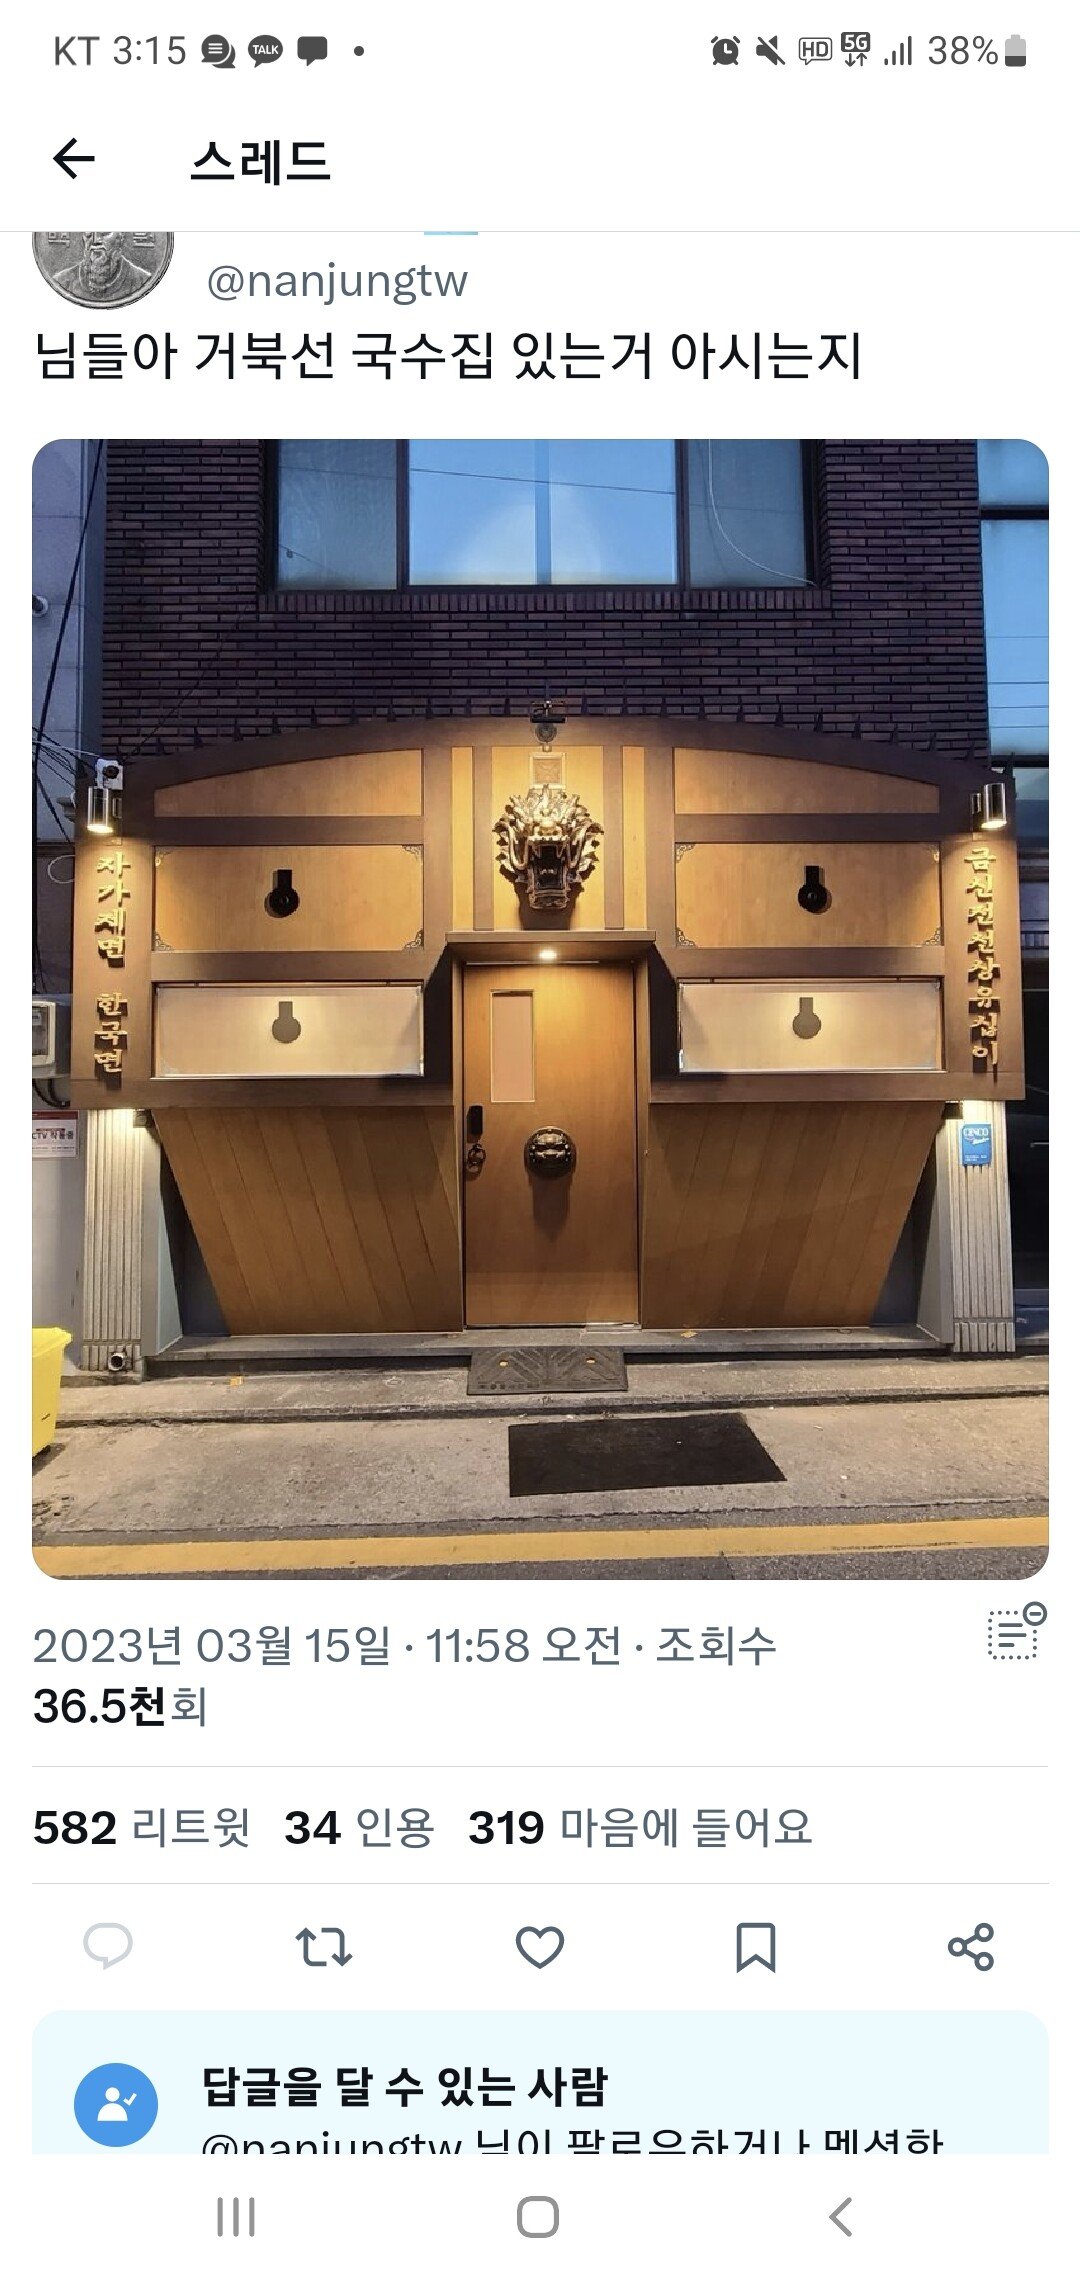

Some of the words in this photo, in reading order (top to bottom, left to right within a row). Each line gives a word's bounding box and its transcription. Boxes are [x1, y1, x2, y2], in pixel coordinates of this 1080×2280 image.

[55, 36, 100, 66] KT
[114, 36, 186, 66] 3:15
[253, 45, 279, 55] TALK
[802, 41, 829, 57] HD
[844, 34, 867, 50] 5G
[928, 35, 998, 65] 38%
[190, 140, 331, 186] 스레드
[207, 262, 469, 305] @nanjungtw
[36, 332, 178, 380] 님들아
[196, 332, 334, 380] 거북선
[352, 332, 492, 380] 국수집
[513, 332, 651, 380] 있는거
[672, 332, 860, 380] 아시는지
[95, 851, 131, 958] 자가제면
[94, 992, 128, 1073] 한국면
[34, 1626, 181, 1666] 2023년
[197, 1626, 291, 1666] 03월
[305, 1626, 390, 1666] 15일
[426, 1629, 530, 1663] 11:58
[543, 1626, 620, 1666] 오전
[657, 1626, 777, 1667] 조회수
[34, 1686, 206, 1728] 36.5천회
[34, 1810, 117, 1845] 582
[134, 1808, 249, 1849] 리트윗
[285, 1810, 342, 1845] 34
[357, 1808, 435, 1849] 인용
[469, 1810, 545, 1845] 319
[562, 1808, 678, 1849] 마음에
[693, 1808, 813, 1849] 들어요
[203, 2067, 322, 2108] 답글을
[337, 2067, 374, 2108] 달
[386, 2067, 424, 2108] 수
[438, 2067, 516, 2108] 있는
[528, 2067, 609, 2108] 사람
